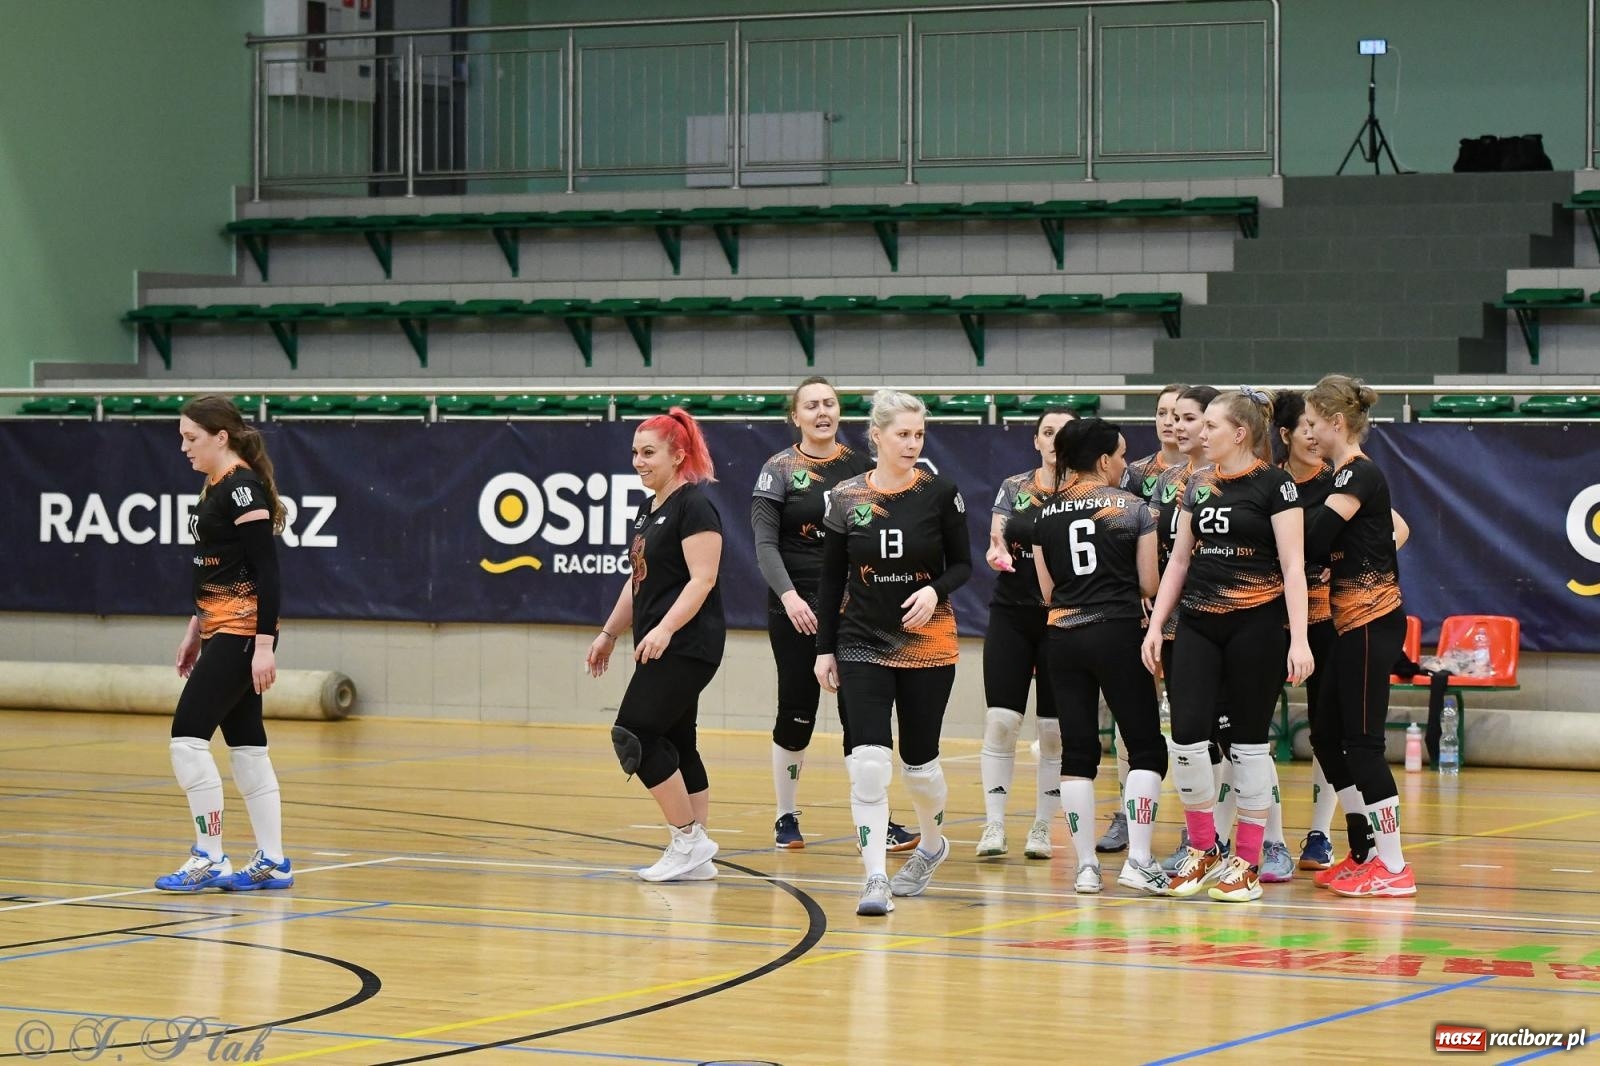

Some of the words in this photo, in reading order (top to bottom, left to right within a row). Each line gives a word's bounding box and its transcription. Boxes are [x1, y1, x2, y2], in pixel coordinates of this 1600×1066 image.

[1041, 498, 1112, 519] MAJEWSKA
[1116, 497, 1129, 509] B.
[1199, 507, 1232, 533] 25
[880, 529, 904, 559] 13
[1068, 518, 1097, 576] 6
[553, 549, 633, 574] RACIBÓ
[873, 572, 913, 584] Fundacja
